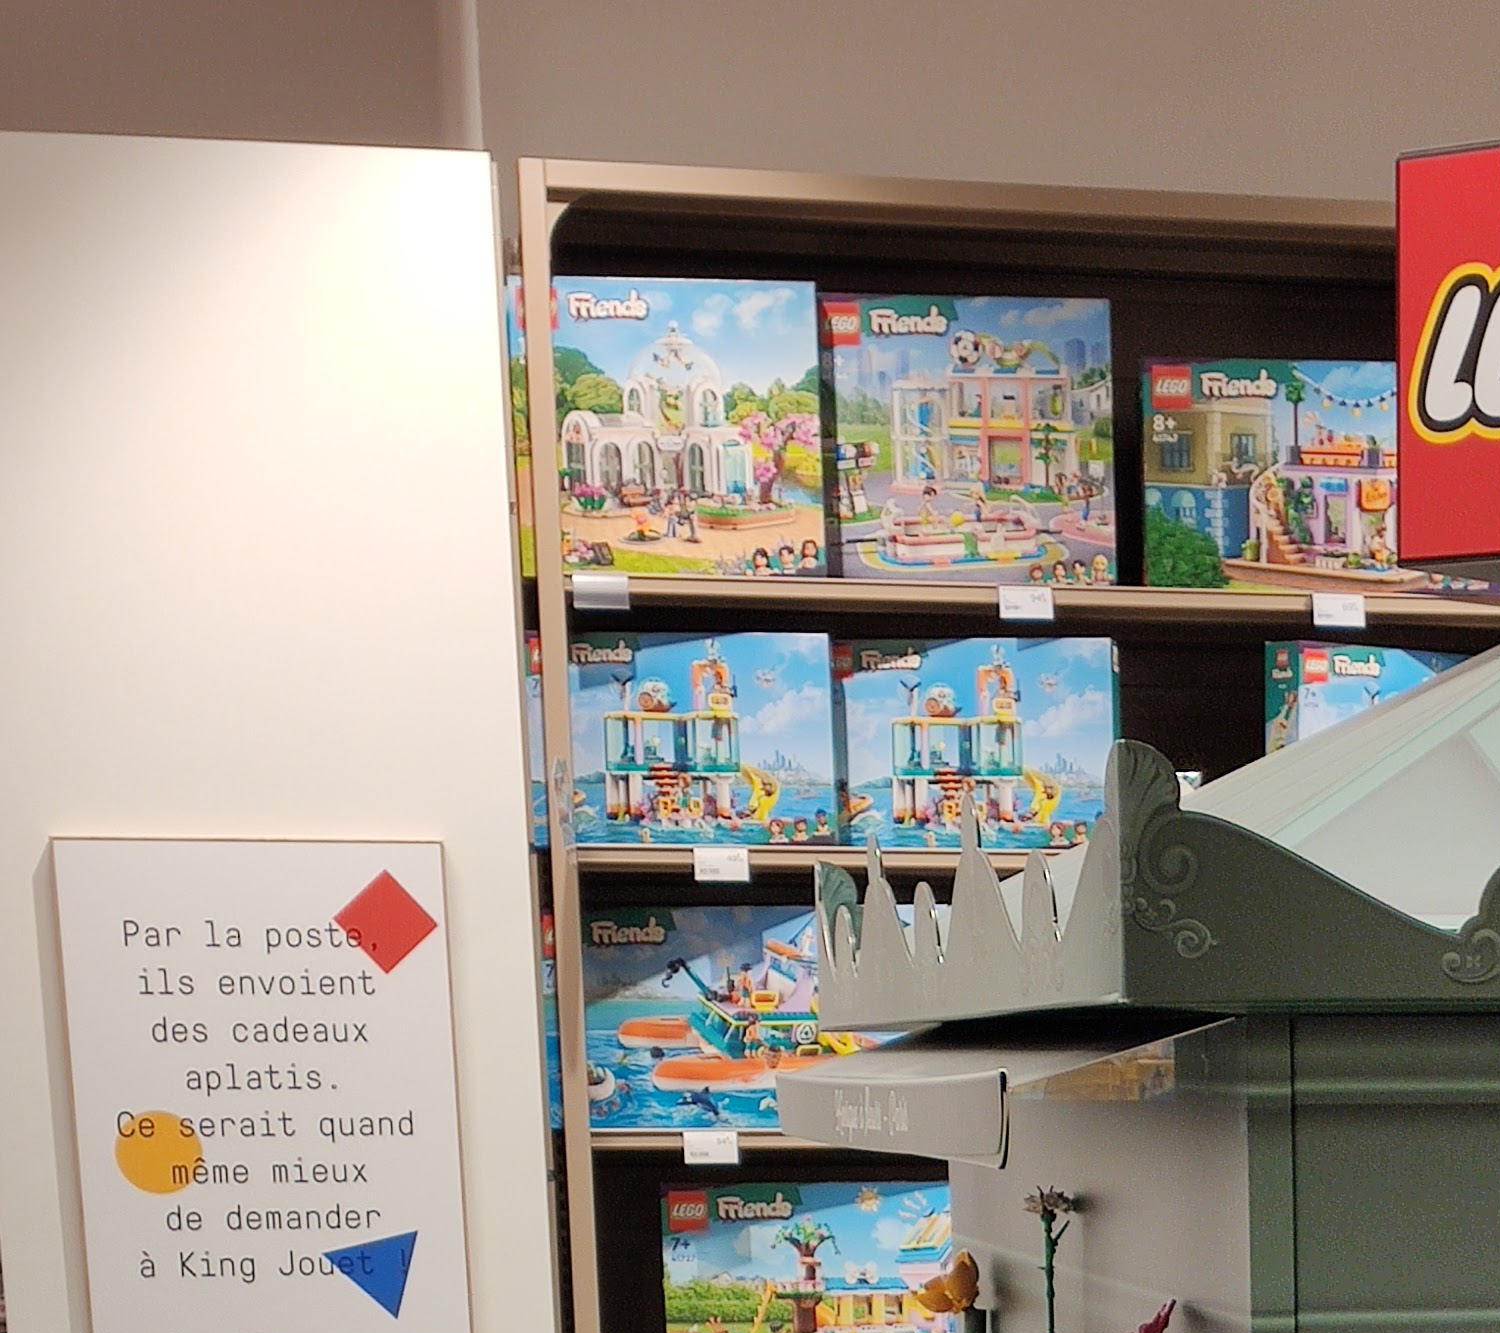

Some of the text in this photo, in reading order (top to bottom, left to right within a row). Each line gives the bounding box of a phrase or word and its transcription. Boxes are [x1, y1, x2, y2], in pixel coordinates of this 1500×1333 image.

[567, 289, 648, 320] Friends
[869, 305, 948, 336] Friends
[1156, 368, 1277, 399] LEGO Friends
[1153, 414, 1177, 431] 8+
[570, 640, 632, 663] Friends
[122, 920, 379, 955] Par la poste,
[590, 917, 667, 947] Friends
[138, 968, 377, 996] ils envoient
[151, 1016, 369, 1044] des cadeaux
[185, 1063, 339, 1098] aplatis.
[116, 1110, 415, 1144] Ce serait quand
[171, 1157, 369, 1185] même mieux
[166, 1204, 382, 1232] de demander
[672, 1192, 793, 1222] LEGO Friends
[671, 1237, 691, 1251] 7+
[139, 1251, 156, 1279] à
[180, 1251, 257, 1284] King
[278, 1249, 375, 1278] Jouet
